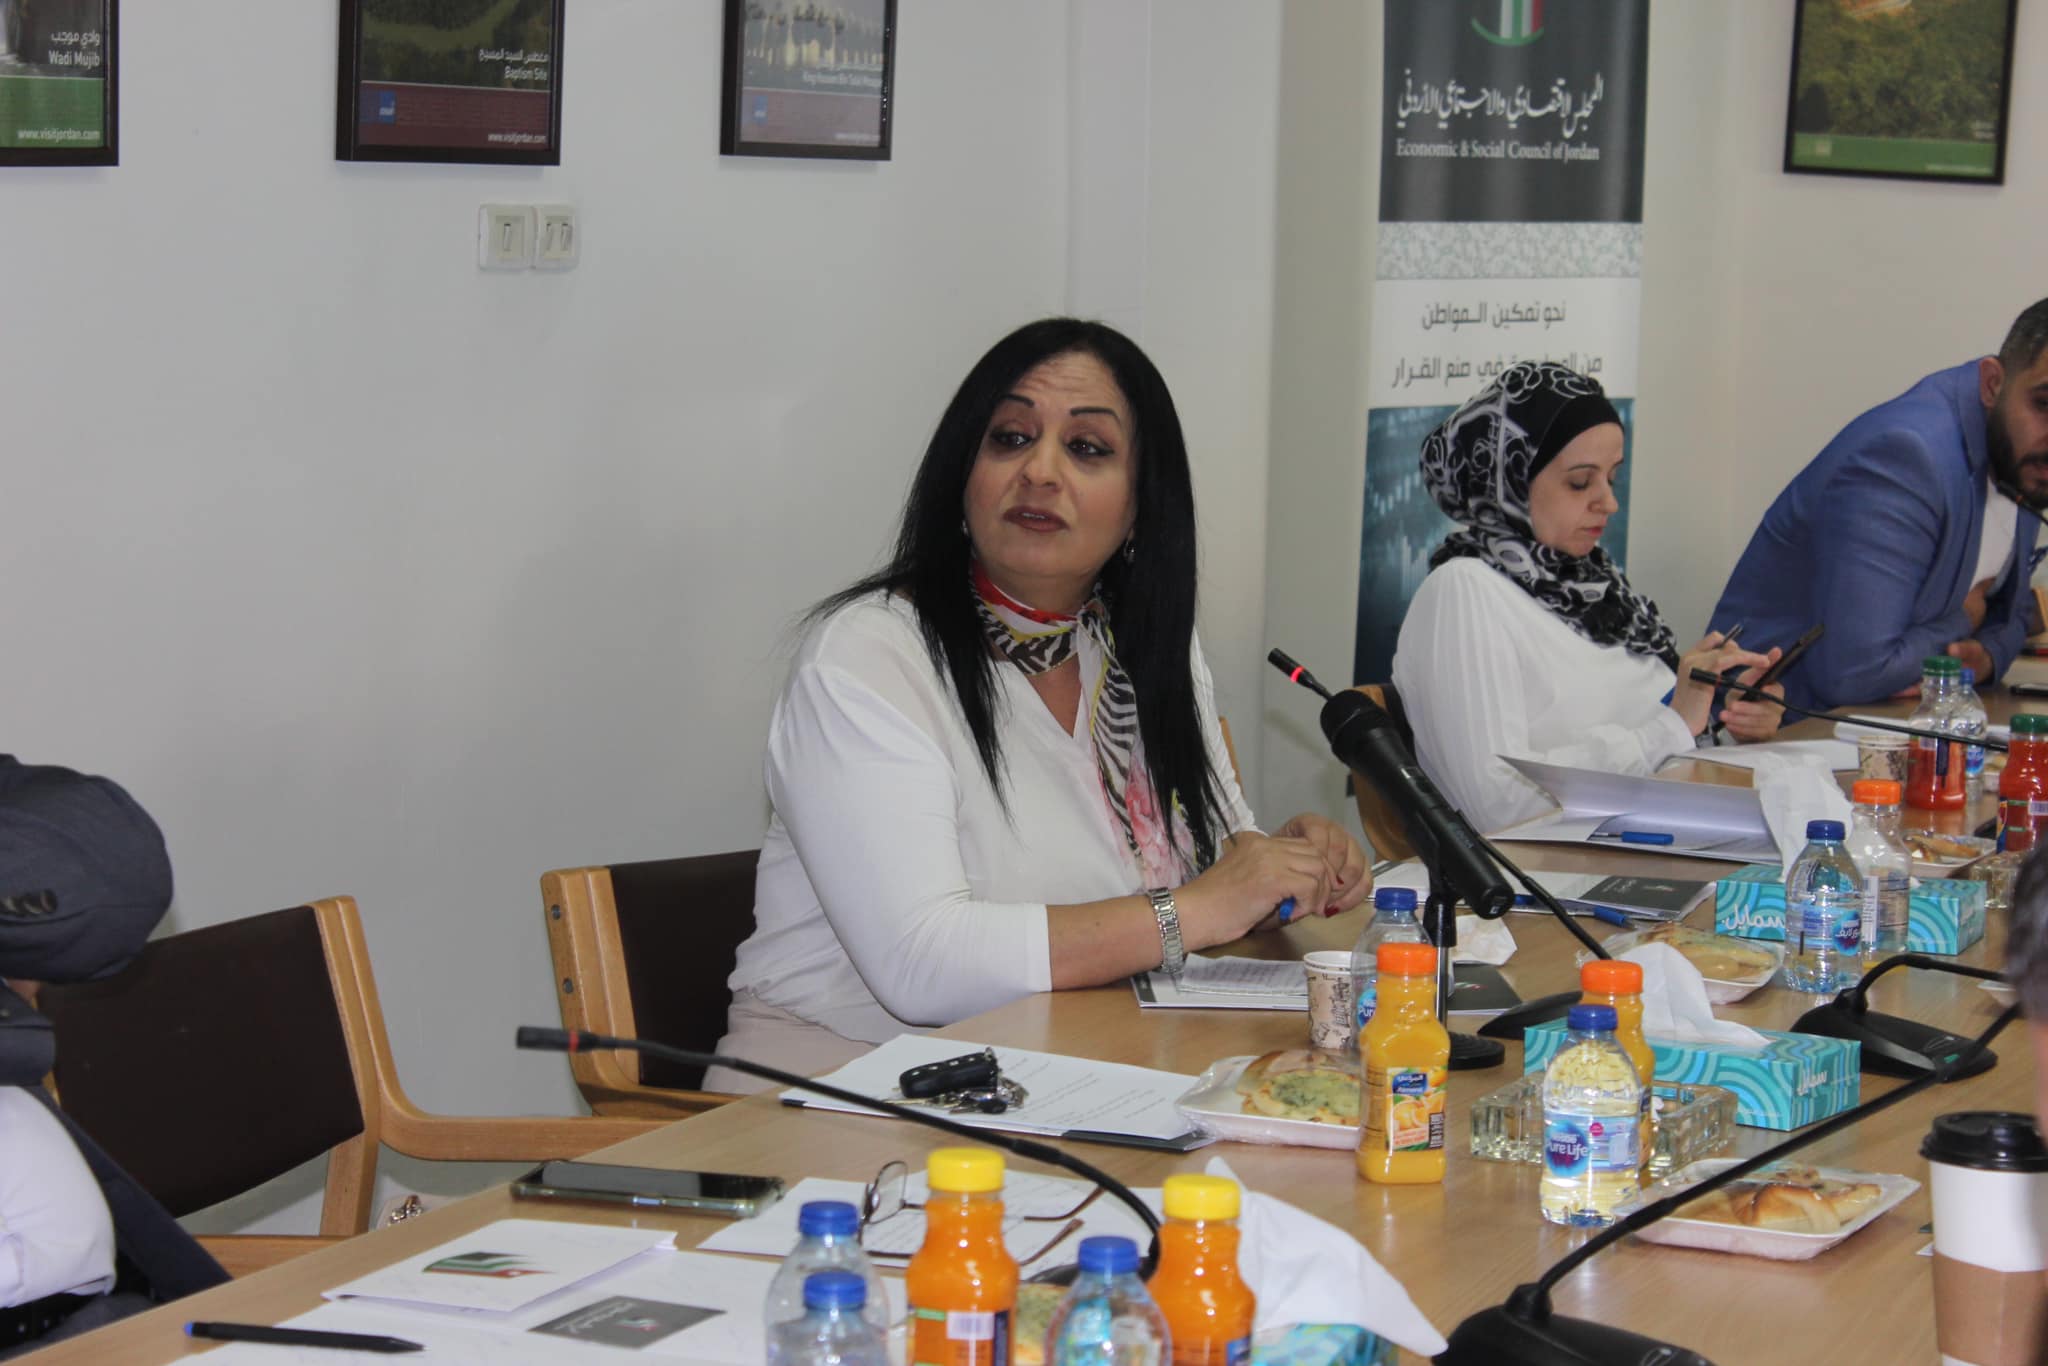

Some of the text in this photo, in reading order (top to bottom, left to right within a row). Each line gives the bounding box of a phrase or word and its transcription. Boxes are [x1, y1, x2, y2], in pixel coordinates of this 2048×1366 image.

[49, 50, 100, 69] Wadi Mujib
[1396, 138, 1600, 164] Economic & Social Council of Jordan
[1421, 301, 1567, 332] نحو تمكين المواطن
[1391, 357, 1441, 389] القرار
[1445, 355, 1471, 388] صنع
[1358, 1005, 1376, 1017] Pur
[1567, 1142, 1588, 1161] Life
